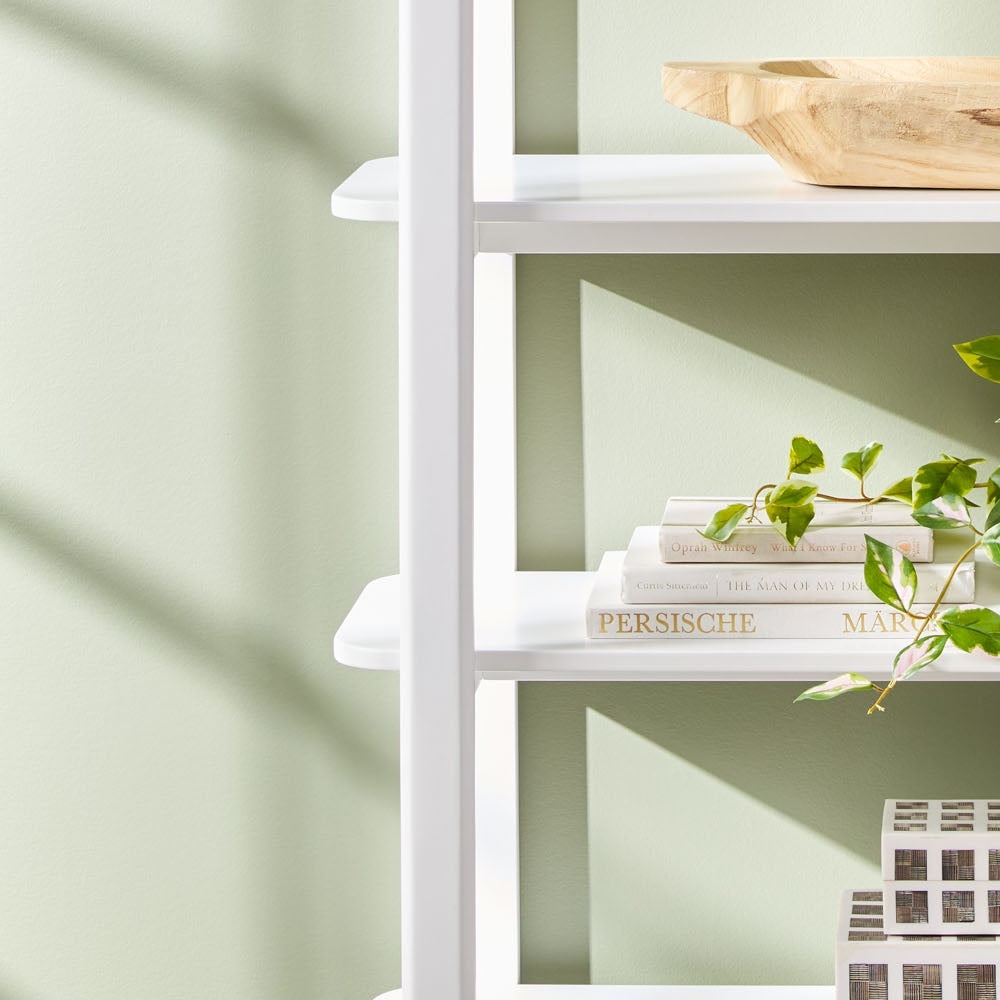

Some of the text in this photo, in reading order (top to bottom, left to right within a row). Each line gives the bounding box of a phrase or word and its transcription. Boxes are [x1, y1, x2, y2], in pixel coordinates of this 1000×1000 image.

[671, 542, 758, 556] Oprah Winfrey
[808, 543, 837, 553] Know
[841, 543, 857, 553] For
[727, 580, 870, 591] THE MAN OF MY DRE
[598, 612, 757, 634] PERSISCHE
